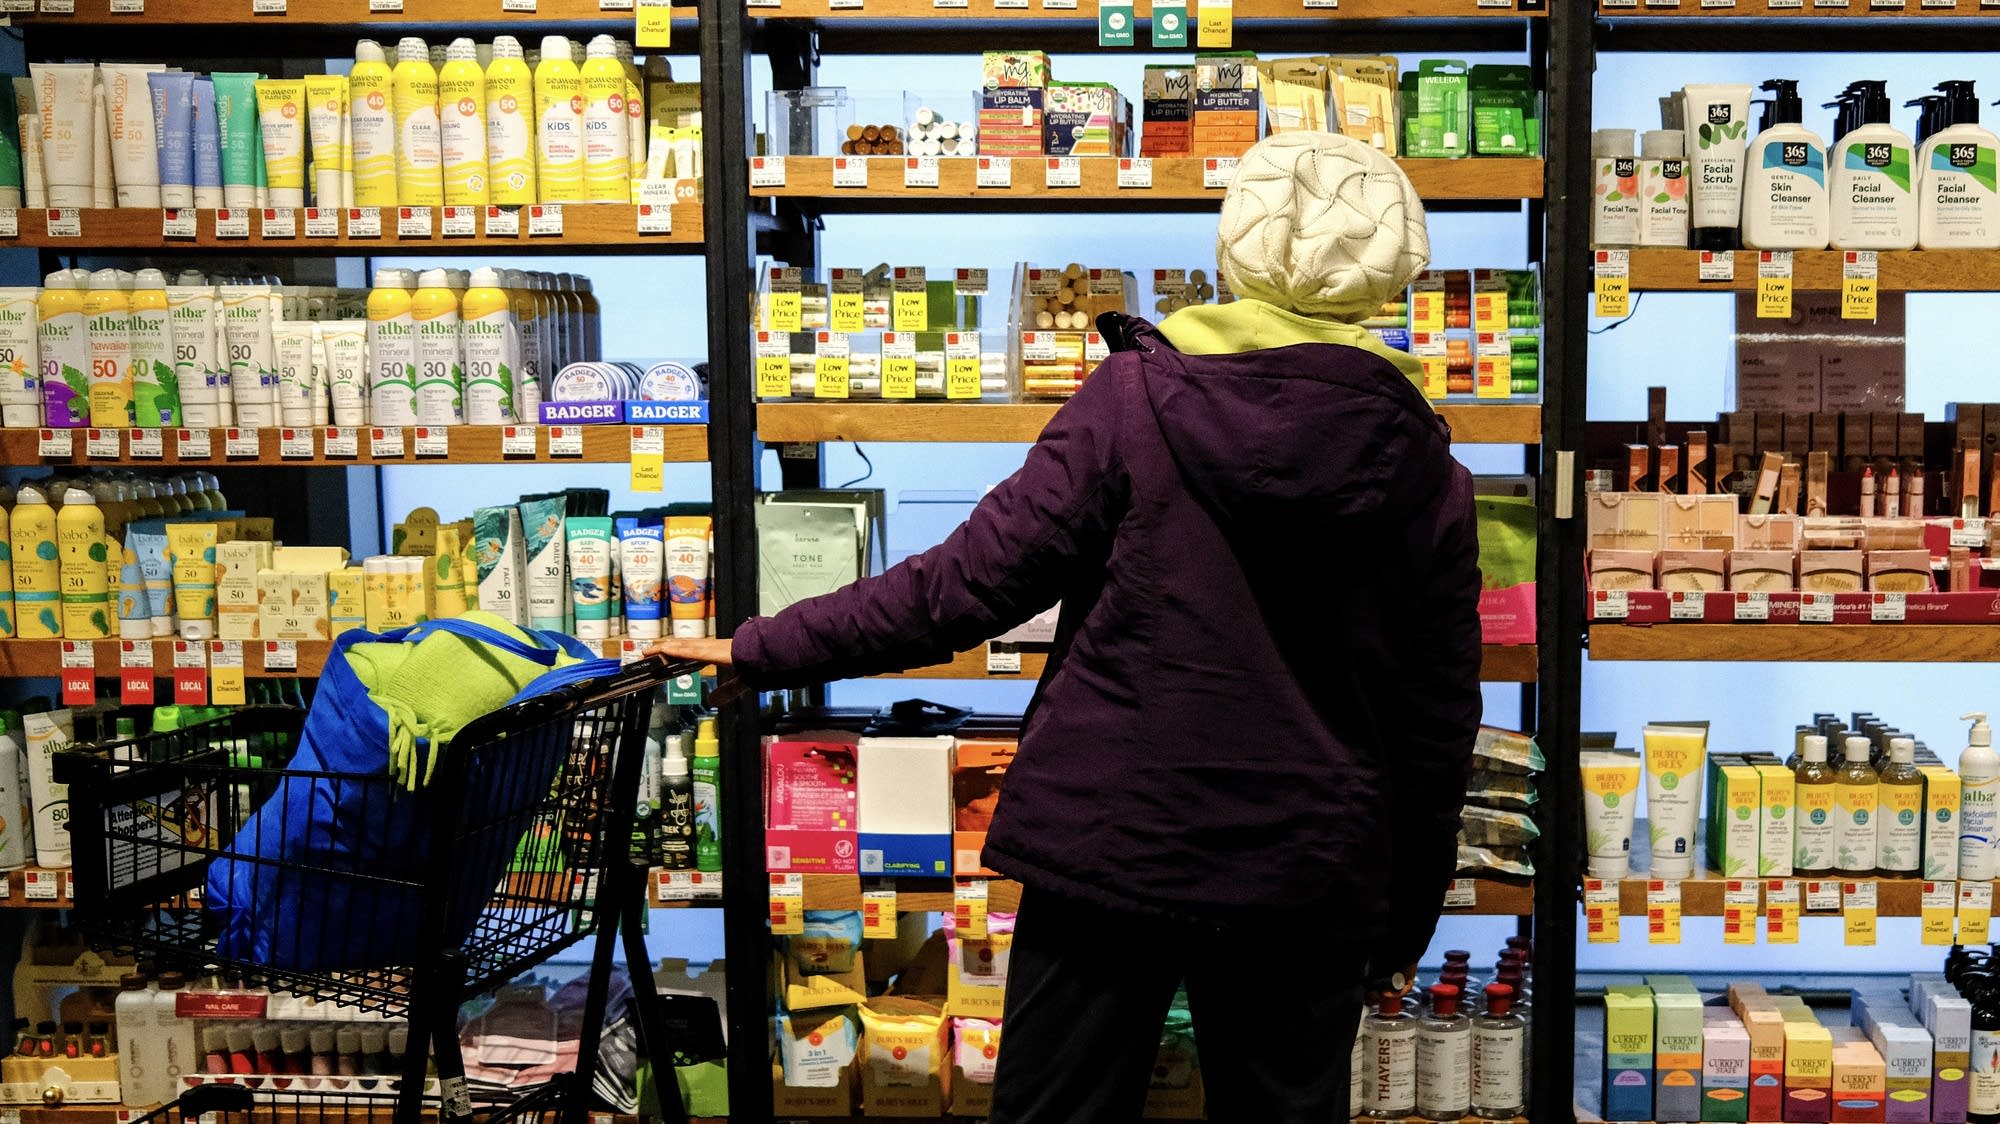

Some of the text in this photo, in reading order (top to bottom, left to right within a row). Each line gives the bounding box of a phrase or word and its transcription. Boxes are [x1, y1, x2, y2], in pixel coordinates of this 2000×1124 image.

[1218, 64, 1243, 88] mg
[1425, 76, 1461, 84] WELEDA
[1165, 75, 1190, 99] mg
[368, 96, 382, 105] 40
[994, 96, 1030, 104] LIP BALM
[1203, 98, 1250, 106] LIP BUTTER
[1479, 97, 1514, 105] WELEDA
[41, 71, 57, 141] thinkbaby
[112, 71, 128, 141] thinkbaby
[1710, 106, 1729, 118] 365
[1784, 146, 1806, 159] 365
[1867, 146, 1890, 160] 365
[1952, 146, 1974, 159] 365
[1616, 160, 1633, 172] 365
[1664, 162, 1680, 173] 365
[1704, 164, 1733, 174] Facial
[1703, 174, 1733, 184] Scrub
[677, 186, 694, 197] 20
[1771, 183, 1792, 192] Skin
[1853, 184, 1882, 192] Facial
[1938, 184, 1966, 192] Facial
[1771, 194, 1812, 203] Cleanser
[1852, 194, 1895, 204] Cleanser
[1937, 194, 1980, 204] Cleanser
[1610, 252, 1628, 262] $7.29
[1603, 283, 1622, 292] Low
[1765, 283, 1784, 292] Low
[1850, 284, 1869, 292] Low
[776, 298, 794, 307] Low
[901, 298, 920, 306] Low
[1599, 294, 1626, 302] Price
[1761, 294, 1789, 303] Price
[1846, 294, 1873, 304] Price
[838, 299, 856, 308] Low
[173, 307, 202, 318] alba
[228, 307, 257, 318] alba
[772, 308, 798, 318] Price
[834, 309, 861, 319] Price
[897, 308, 924, 318] Price
[89, 316, 127, 332] alba
[378, 321, 412, 336] alba
[420, 321, 454, 336] alba
[468, 321, 502, 336] alba
[175, 330, 205, 339] mineral
[230, 330, 260, 339] mineral
[176, 345, 197, 360] 50
[231, 344, 252, 360] 30
[379, 348, 410, 356] mineral
[422, 348, 454, 356] mineral
[470, 348, 500, 356] mineral
[93, 359, 118, 378] 50
[380, 362, 404, 378] 50
[423, 361, 446, 378] 30
[470, 362, 492, 378] 30
[764, 362, 782, 371] Low
[824, 362, 842, 371] Low
[889, 364, 908, 372] Low
[954, 364, 972, 372] Low
[282, 367, 296, 378] 50
[337, 368, 353, 380] 30
[564, 368, 598, 381] BADGER
[655, 368, 687, 381] BADGER
[760, 373, 787, 383] Price
[819, 373, 846, 383] Price
[886, 374, 912, 384] Price
[951, 374, 978, 385] Price
[546, 404, 616, 420] BADGER
[632, 406, 701, 418] BADGER
[635, 472, 660, 480] Chance!
[570, 527, 605, 538] BADGER
[623, 528, 661, 539] BADGER
[669, 527, 706, 538] BADGER
[179, 534, 204, 544] babo
[223, 549, 248, 558] babo
[792, 554, 823, 562] TONE
[580, 554, 594, 565] 40
[633, 554, 648, 565] 40
[678, 554, 694, 564] 40
[144, 568, 158, 577] 50
[184, 569, 197, 578] 50
[545, 566, 560, 577] 30
[18, 576, 32, 586] 50
[69, 578, 84, 588] 30
[231, 590, 244, 600] 50
[497, 590, 511, 600] 30
[386, 611, 402, 621] 30
[284, 619, 298, 628] 50
[68, 681, 90, 690] LOCAL
[127, 681, 150, 690] LOCAL
[180, 681, 202, 690] LOCAL
[1652, 750, 1688, 760] BURT'S
[1657, 760, 1683, 769] BEES
[776, 764, 786, 804] ANDALOU
[1600, 782, 1623, 791] BEES
[1964, 790, 1996, 802] alba
[52, 808, 69, 822] 80
[205, 1003, 240, 1011] NAIL CARE
[876, 1036, 924, 1044] BURT'S BEES
[1612, 1034, 1648, 1044] CURRENT
[1662, 1036, 1698, 1046] CURRENT
[1938, 1036, 1968, 1045] CURRENT
[1620, 1042, 1641, 1050] STATE
[1752, 1046, 1781, 1054] CURRENT
[1473, 1034, 1482, 1096] THAYERS
[1708, 1058, 1744, 1068] CURRENT
[1790, 1058, 1827, 1068] CURRENT
[1891, 1057, 1928, 1068] CURRENT
[1378, 1038, 1391, 1102] THAYERS
[1842, 1074, 1878, 1084] CURRENT
